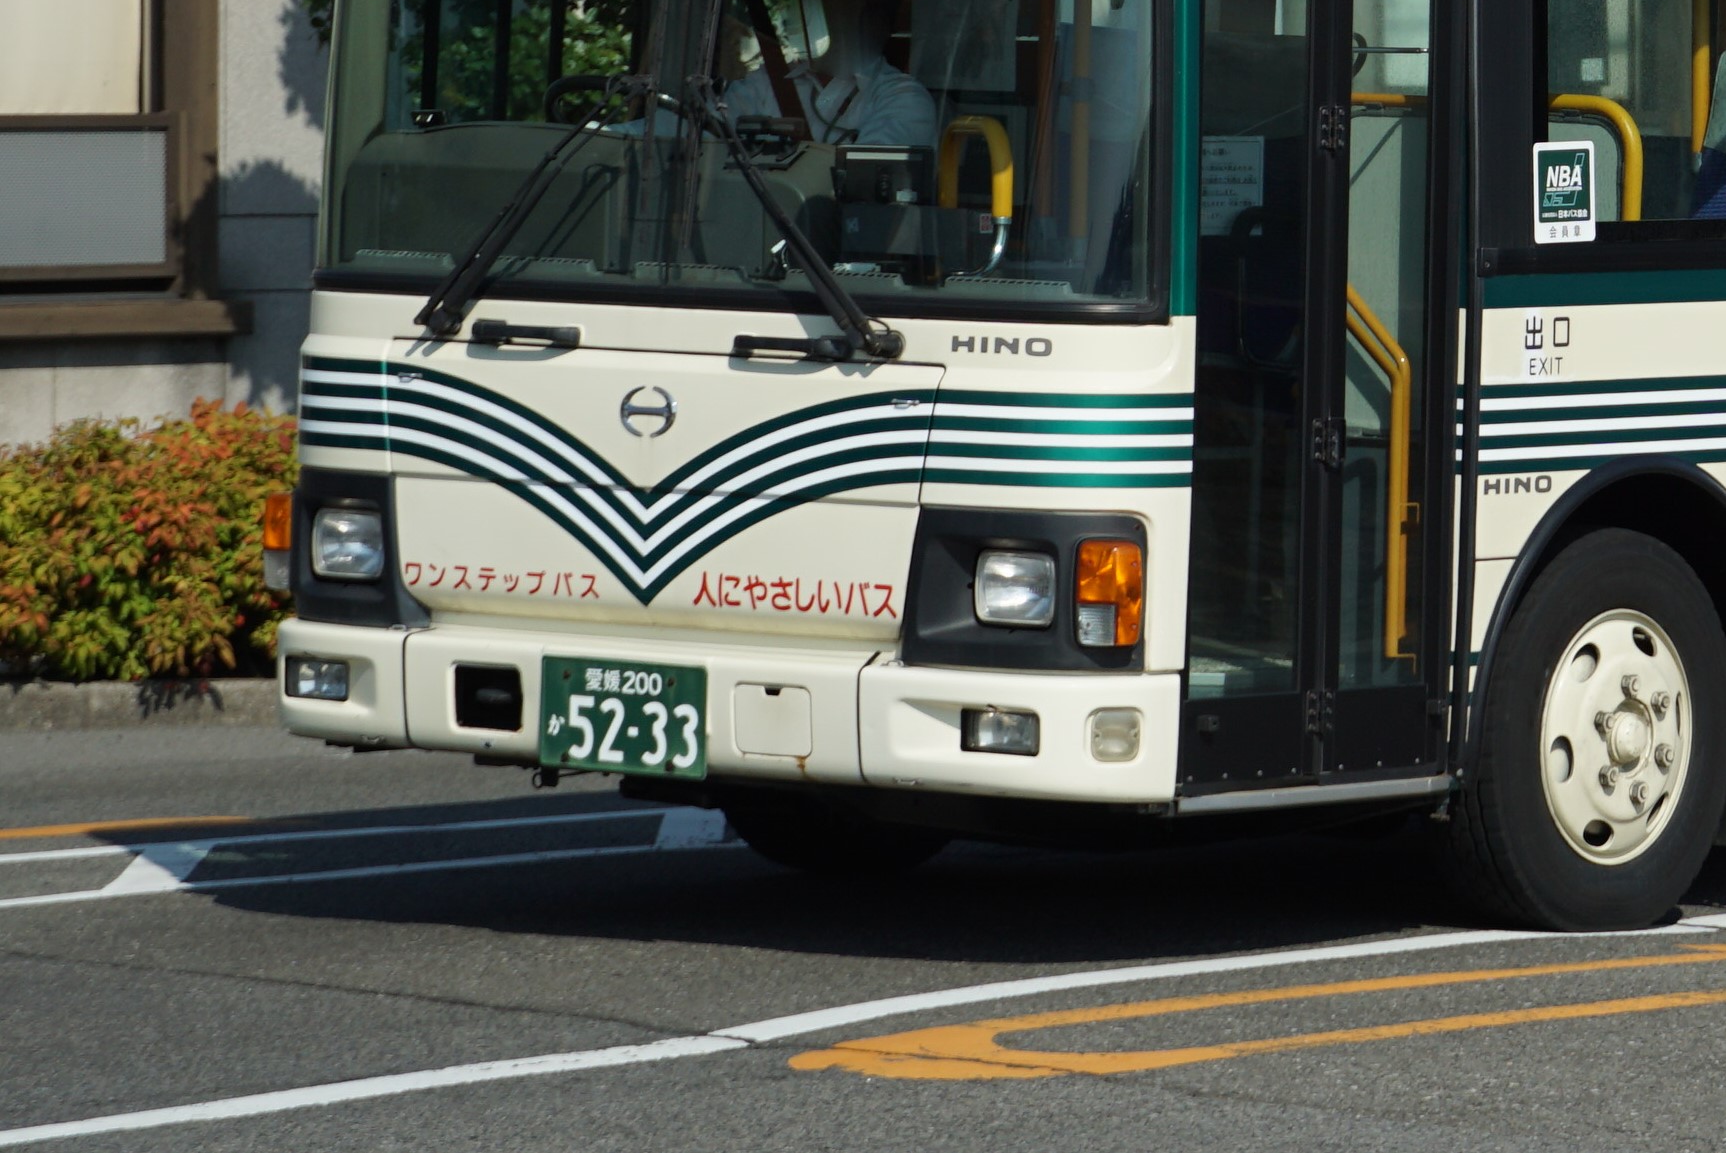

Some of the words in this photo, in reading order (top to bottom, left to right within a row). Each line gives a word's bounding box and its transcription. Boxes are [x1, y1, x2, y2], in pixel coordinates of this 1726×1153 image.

[1546, 165, 1582, 188] NBA
[951, 334, 1053, 357] HINO
[1525, 315, 1570, 350] 出口
[1528, 356, 1564, 376] EXIT
[1483, 474, 1553, 496] HINO
[404, 562, 601, 600] ワンステップバス
[693, 570, 898, 620] 人にやさしいバス
[547, 714, 567, 737] か
[568, 694, 699, 769] 52-33
